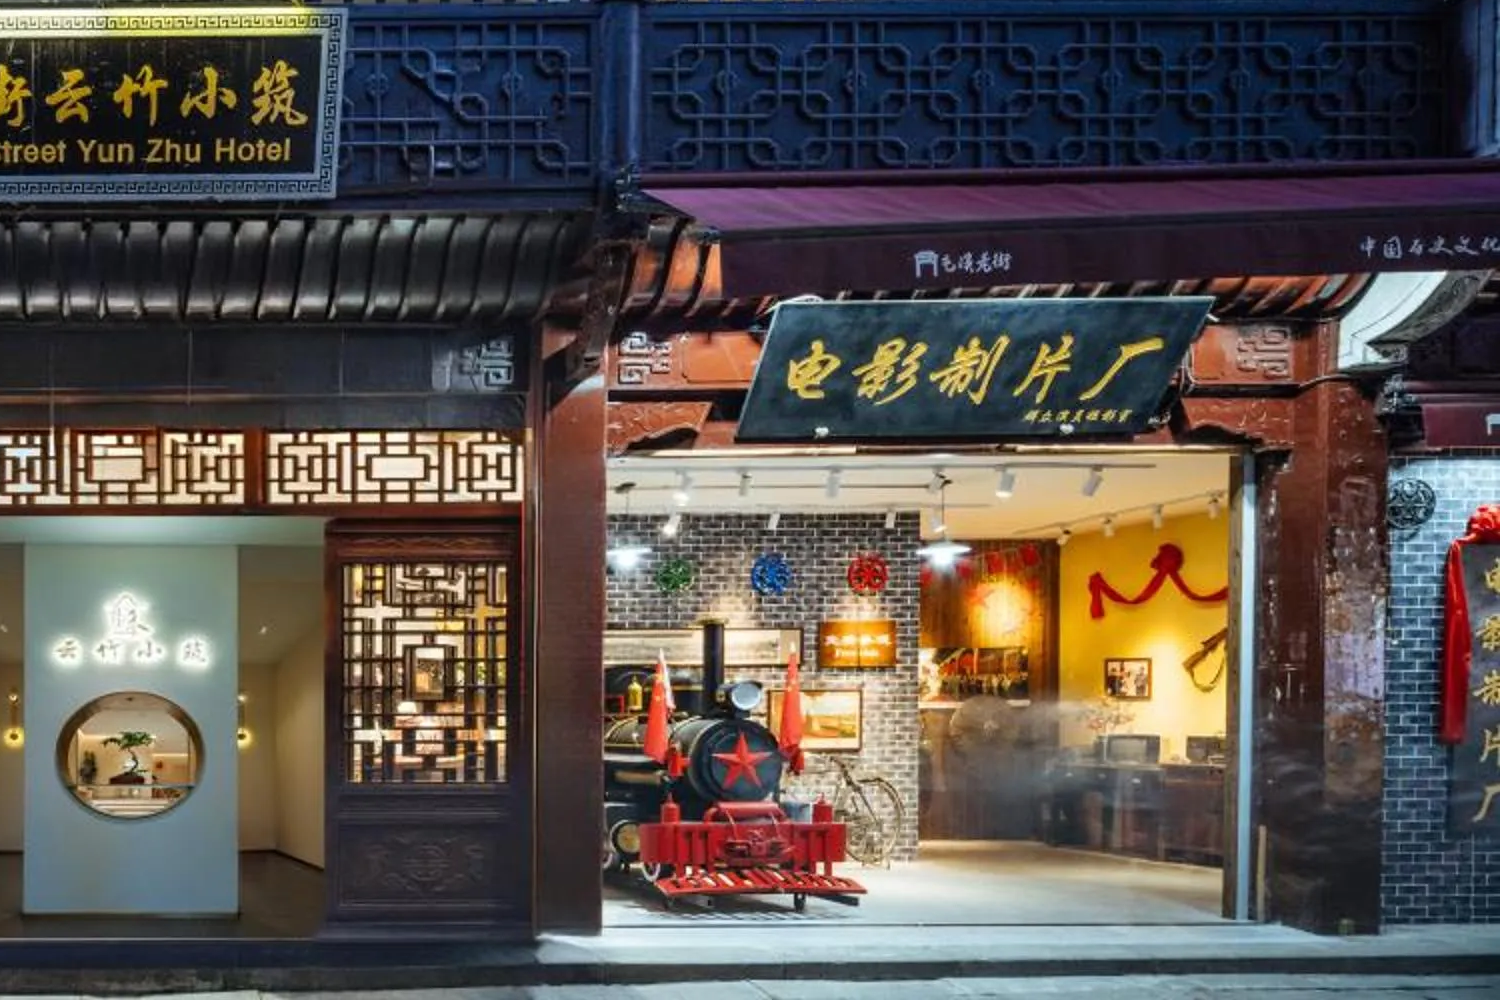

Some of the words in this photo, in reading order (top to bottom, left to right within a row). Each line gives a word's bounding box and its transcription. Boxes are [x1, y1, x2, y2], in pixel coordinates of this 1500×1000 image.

[77, 138, 134, 164] Yun
[145, 137, 201, 163] Zhu
[215, 137, 291, 163] Hotel
[787, 333, 1164, 405] 电影制片厂
